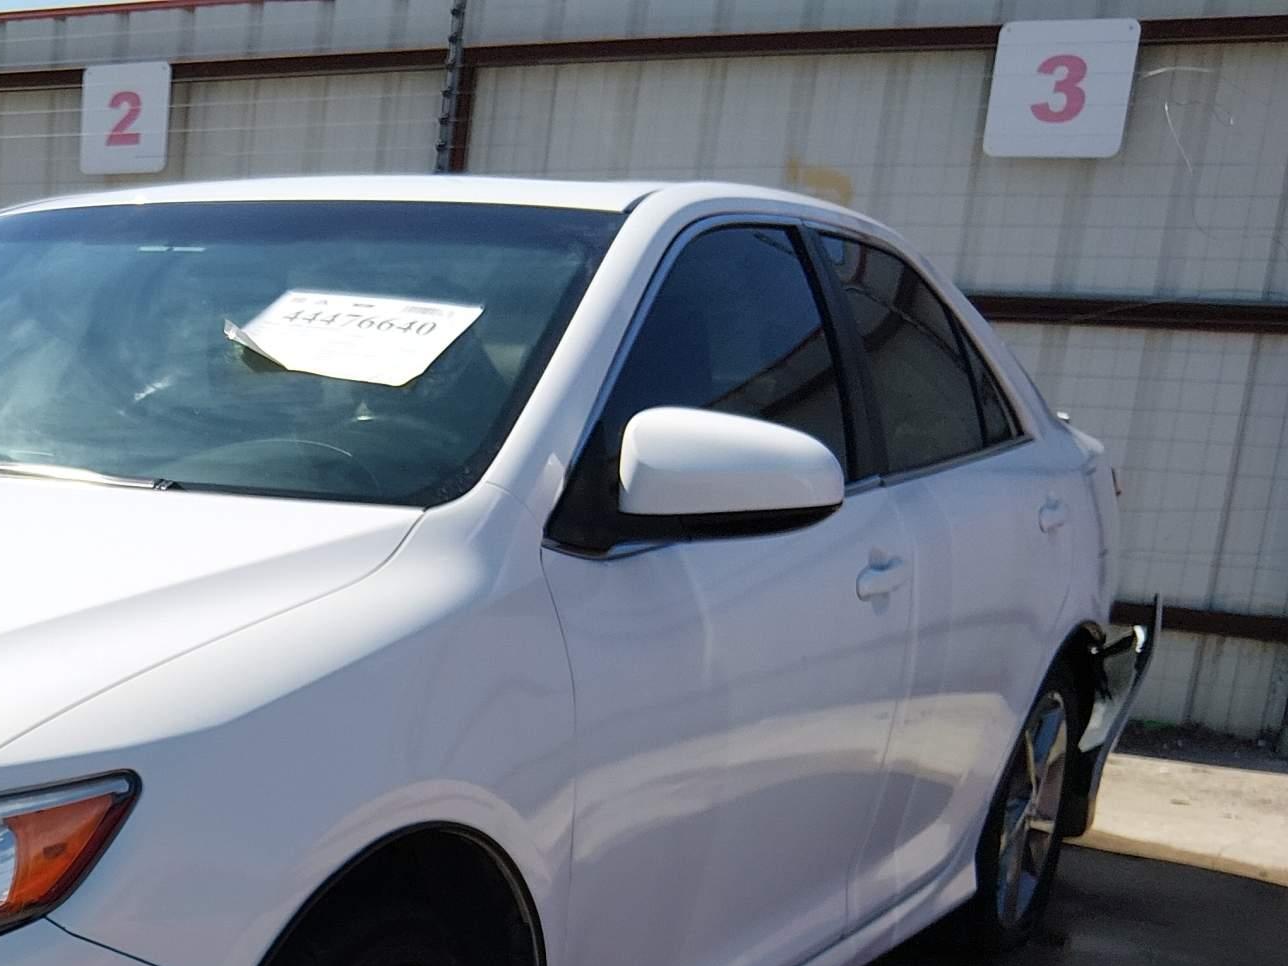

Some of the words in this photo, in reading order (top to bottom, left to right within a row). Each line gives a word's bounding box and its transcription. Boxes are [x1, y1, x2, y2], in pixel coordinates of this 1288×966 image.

[1030, 54, 1087, 123] 3
[105, 91, 142, 146] 2
[283, 310, 437, 336] 44476640
